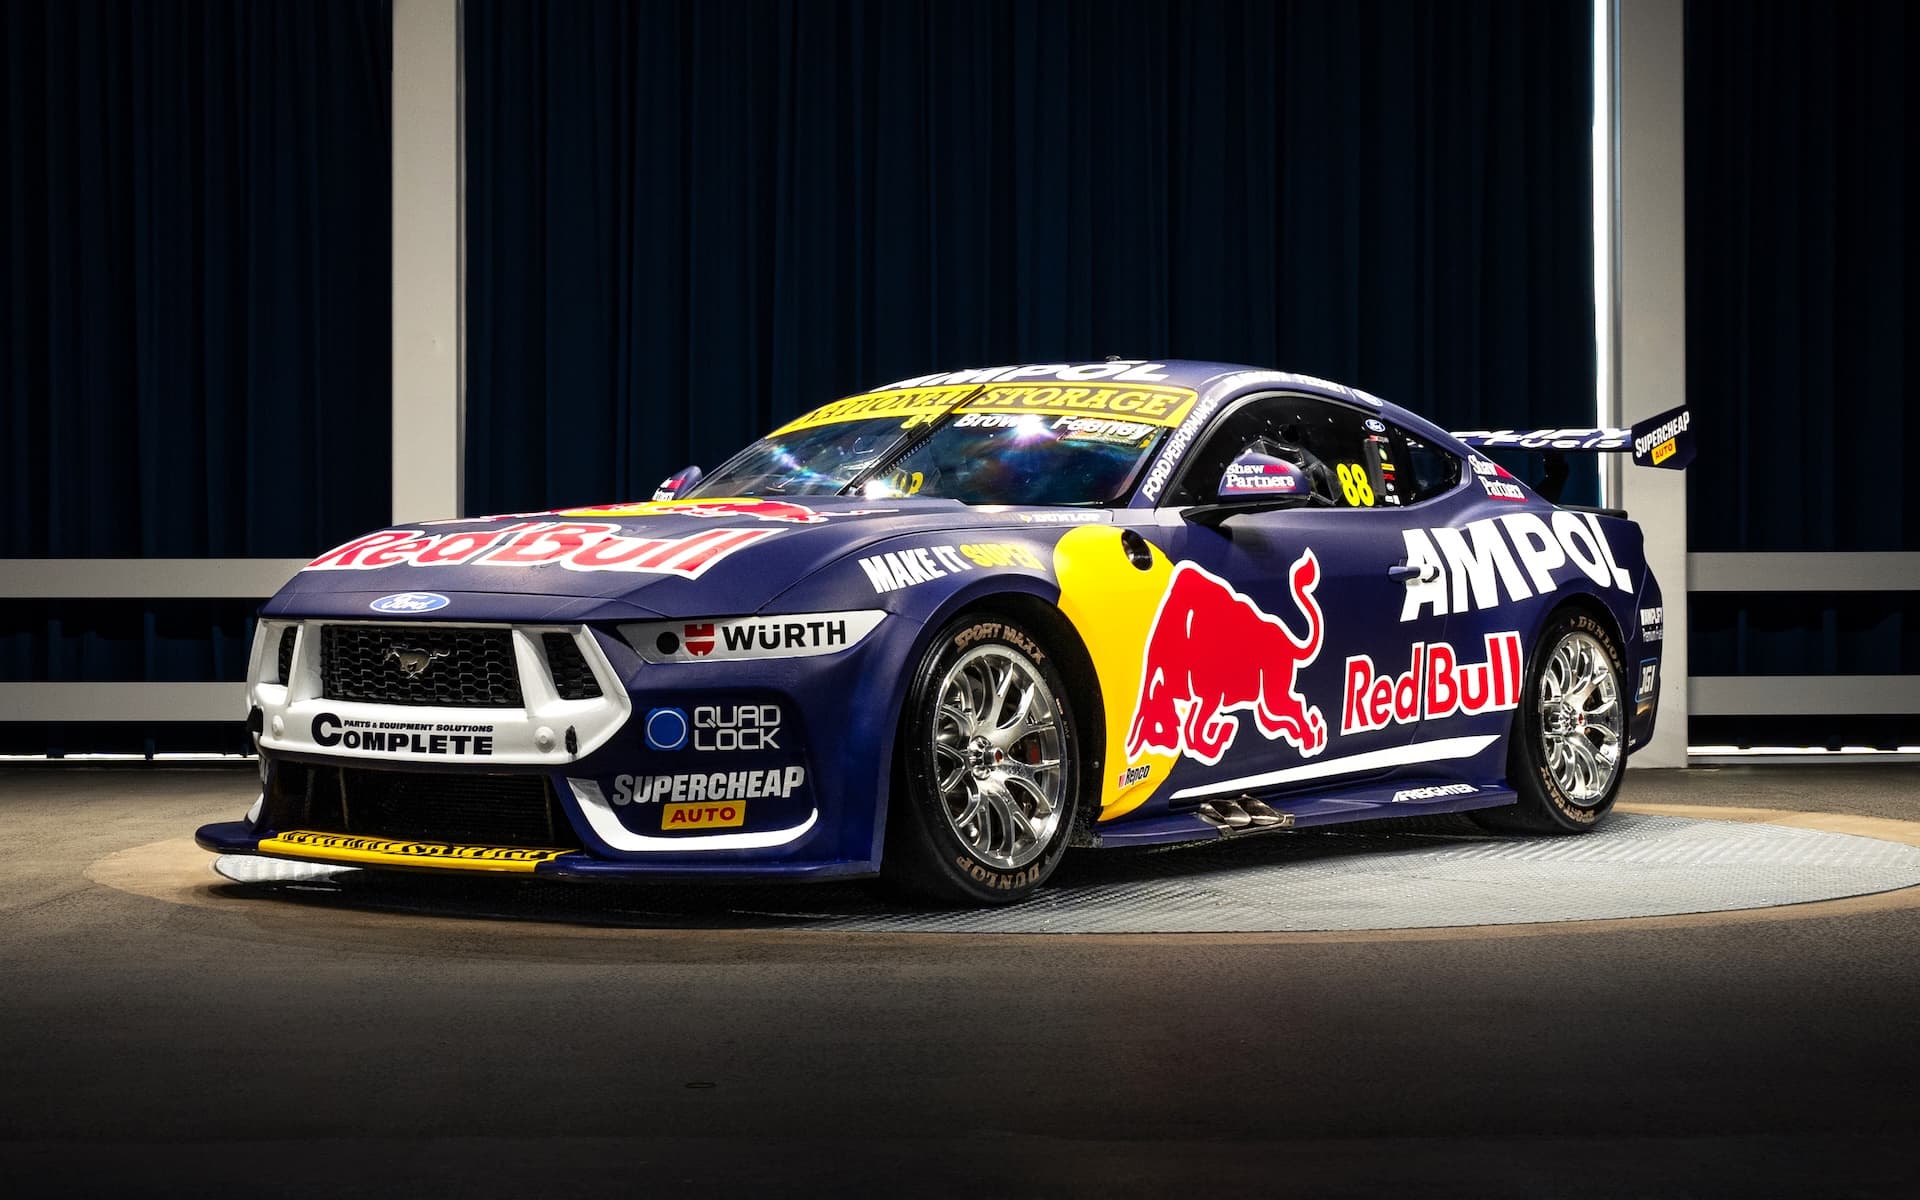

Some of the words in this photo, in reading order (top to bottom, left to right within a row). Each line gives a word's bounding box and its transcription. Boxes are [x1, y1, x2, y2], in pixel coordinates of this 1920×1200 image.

[869, 360, 1170, 393] AMPOL
[977, 386, 1178, 416] STORAGE
[953, 413, 1042, 431] Brow
[1051, 415, 1155, 441] Feeney
[1635, 411, 1690, 458] SUPERCHEAP
[1142, 459, 1172, 502] FORD
[1163, 396, 1218, 466] PERFORMANCE
[1468, 455, 1498, 476] Shaw
[1655, 443, 1673, 459] AUTO
[1226, 475, 1295, 488] Partners
[1336, 464, 1375, 506] 88
[303, 522, 526, 571] Red
[473, 522, 788, 580] Bull
[1400, 510, 1634, 622] AMPOL
[858, 548, 948, 594] MAKE
[931, 545, 973, 574] IT
[380, 593, 437, 610] Ford
[722, 619, 847, 651] WÜRTH
[954, 623, 1002, 652] SPORT
[1003, 624, 1045, 665] MAXX
[1577, 616, 1624, 672] DUNLOP
[1340, 641, 1425, 736] Red
[1424, 631, 1524, 720] Bull
[344, 719, 371, 729] PARTS
[379, 722, 434, 731] EQUIPMENT
[436, 724, 494, 733] SOLUTIONS
[694, 705, 781, 728] QUAD
[311, 713, 493, 755] COMPLETE
[694, 728, 781, 750] LOCK
[612, 766, 805, 806] SUPERCHEAP
[1125, 766, 1150, 786] Repco
[670, 807, 736, 823] AUTO
[955, 854, 1040, 890] DUNLOP
